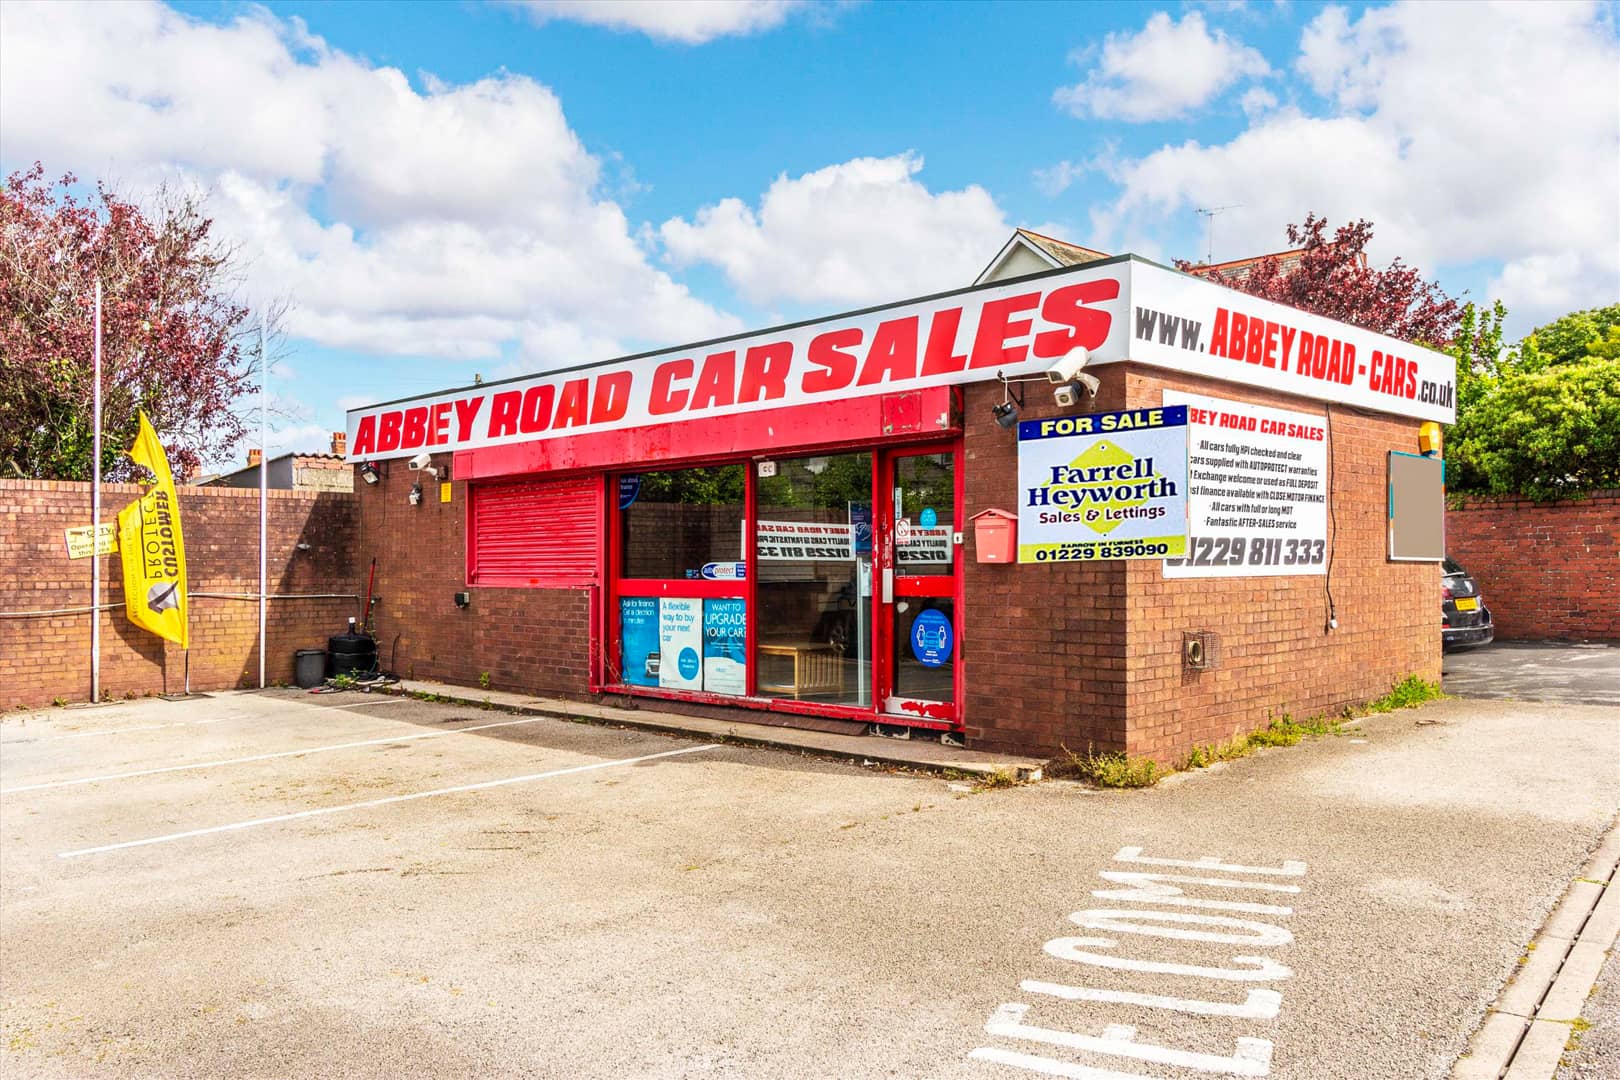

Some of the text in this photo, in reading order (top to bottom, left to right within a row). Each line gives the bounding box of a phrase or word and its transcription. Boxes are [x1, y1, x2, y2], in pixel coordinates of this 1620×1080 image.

[352, 278, 1121, 455] ABBEY ROAD CAR SALES
[1041, 410, 1164, 436] FOR SALE
[1190, 408, 1325, 442] BEY ROAD CAR SALES
[1209, 443, 1225, 452] cars
[1225, 443, 1240, 456] fully
[1240, 445, 1250, 455] HPI
[1250, 446, 1276, 458] checked
[1276, 450, 1288, 459] and
[1287, 451, 1302, 461] clear
[1050, 457, 1155, 486] Farrell
[1205, 457, 1235, 469] supplied
[1235, 459, 1249, 469] with
[1249, 460, 1288, 473] AUTOPROTECT
[1288, 466, 1318, 476] warranties
[1193, 470, 1227, 484] Exchange
[1228, 474, 1256, 484] welcome
[1256, 477, 1263, 485] or
[1263, 477, 1278, 486] used
[1278, 479, 1286, 487] as
[1286, 478, 1297, 488] FULL
[1297, 480, 1318, 489] DEPOSIT
[1026, 477, 1178, 509] Heyworth
[1200, 485, 1226, 497] finance
[1226, 488, 1256, 499] available
[1256, 490, 1269, 500] with
[1269, 491, 1286, 501] CLOSE
[1286, 492, 1304, 502] MOTOR
[1304, 494, 1325, 503] FINANCE
[1039, 506, 1166, 524] Sales & Lettings
[1221, 504, 1236, 512] cars
[1236, 504, 1250, 513] with
[1251, 504, 1261, 514] full
[1261, 506, 1268, 514] or
[1268, 505, 1281, 516] long
[1281, 506, 1293, 515] MOT
[1206, 516, 1297, 529] Fantastic AFTER-SALES service
[86, 527, 112, 538] CTV
[1035, 543, 1168, 561] 01229 839090
[1248, 537, 1283, 566] 811
[1284, 538, 1325, 566] 333
[711, 603, 742, 612] WANT TO
[705, 613, 746, 625] UPGRADE
[705, 627, 727, 637] YOUR
